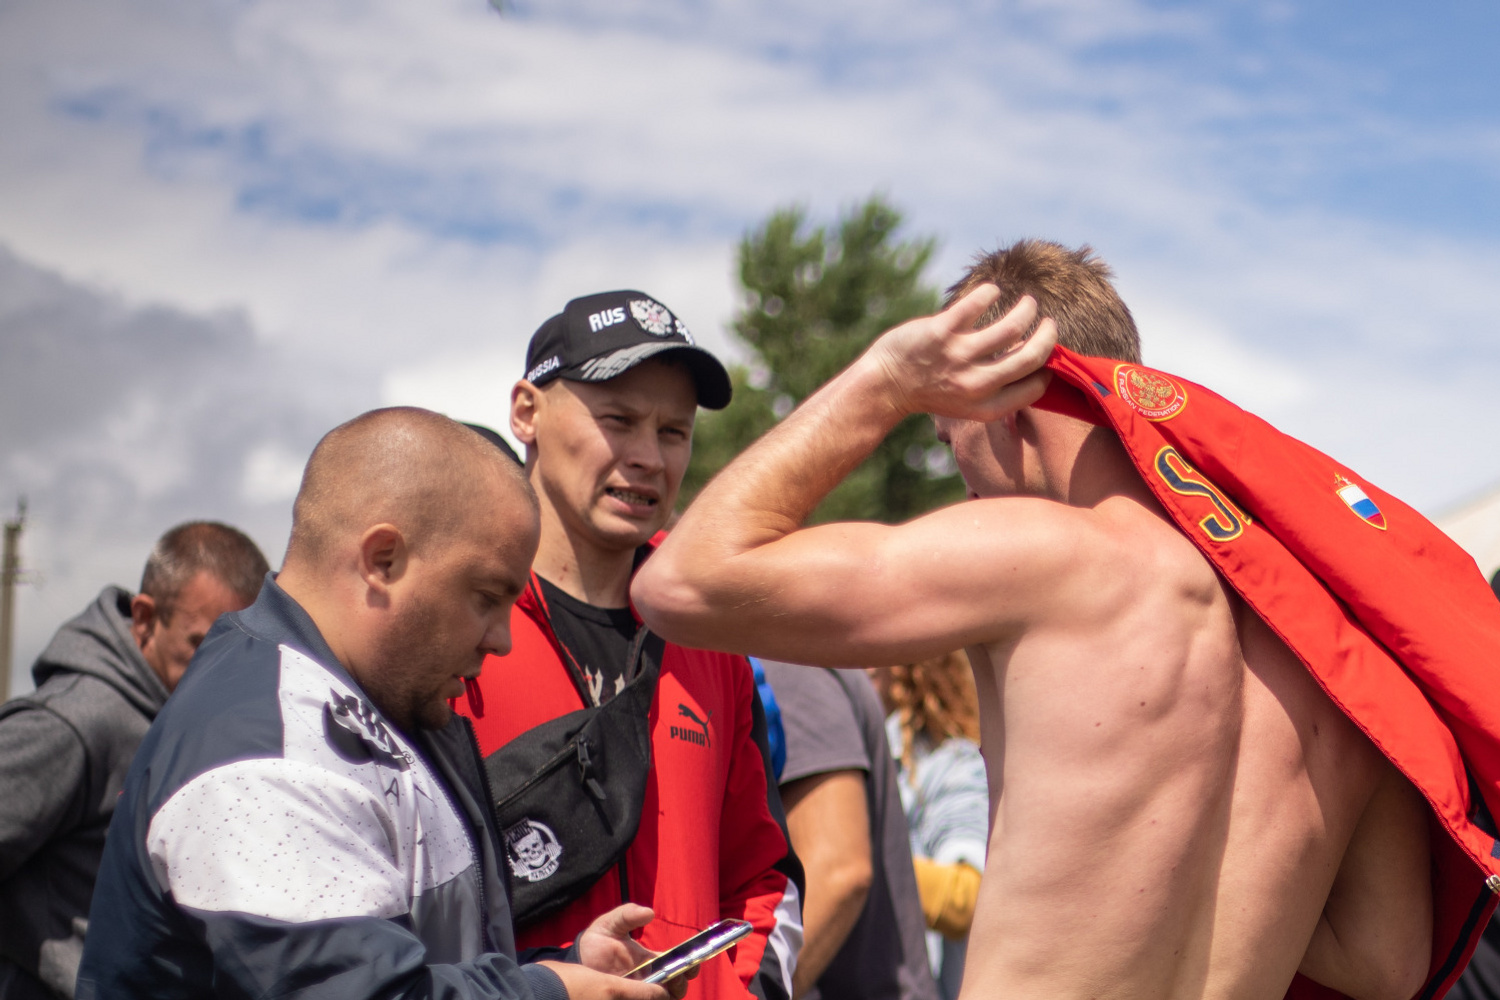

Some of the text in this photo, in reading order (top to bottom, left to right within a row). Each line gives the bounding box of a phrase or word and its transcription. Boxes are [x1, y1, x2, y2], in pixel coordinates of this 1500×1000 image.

[588, 306, 627, 333] RUS
[527, 355, 560, 382] RUSSIA
[1119, 378, 1181, 418] RUSSIAN FEDERATION
[670, 726, 706, 747] PUMA
